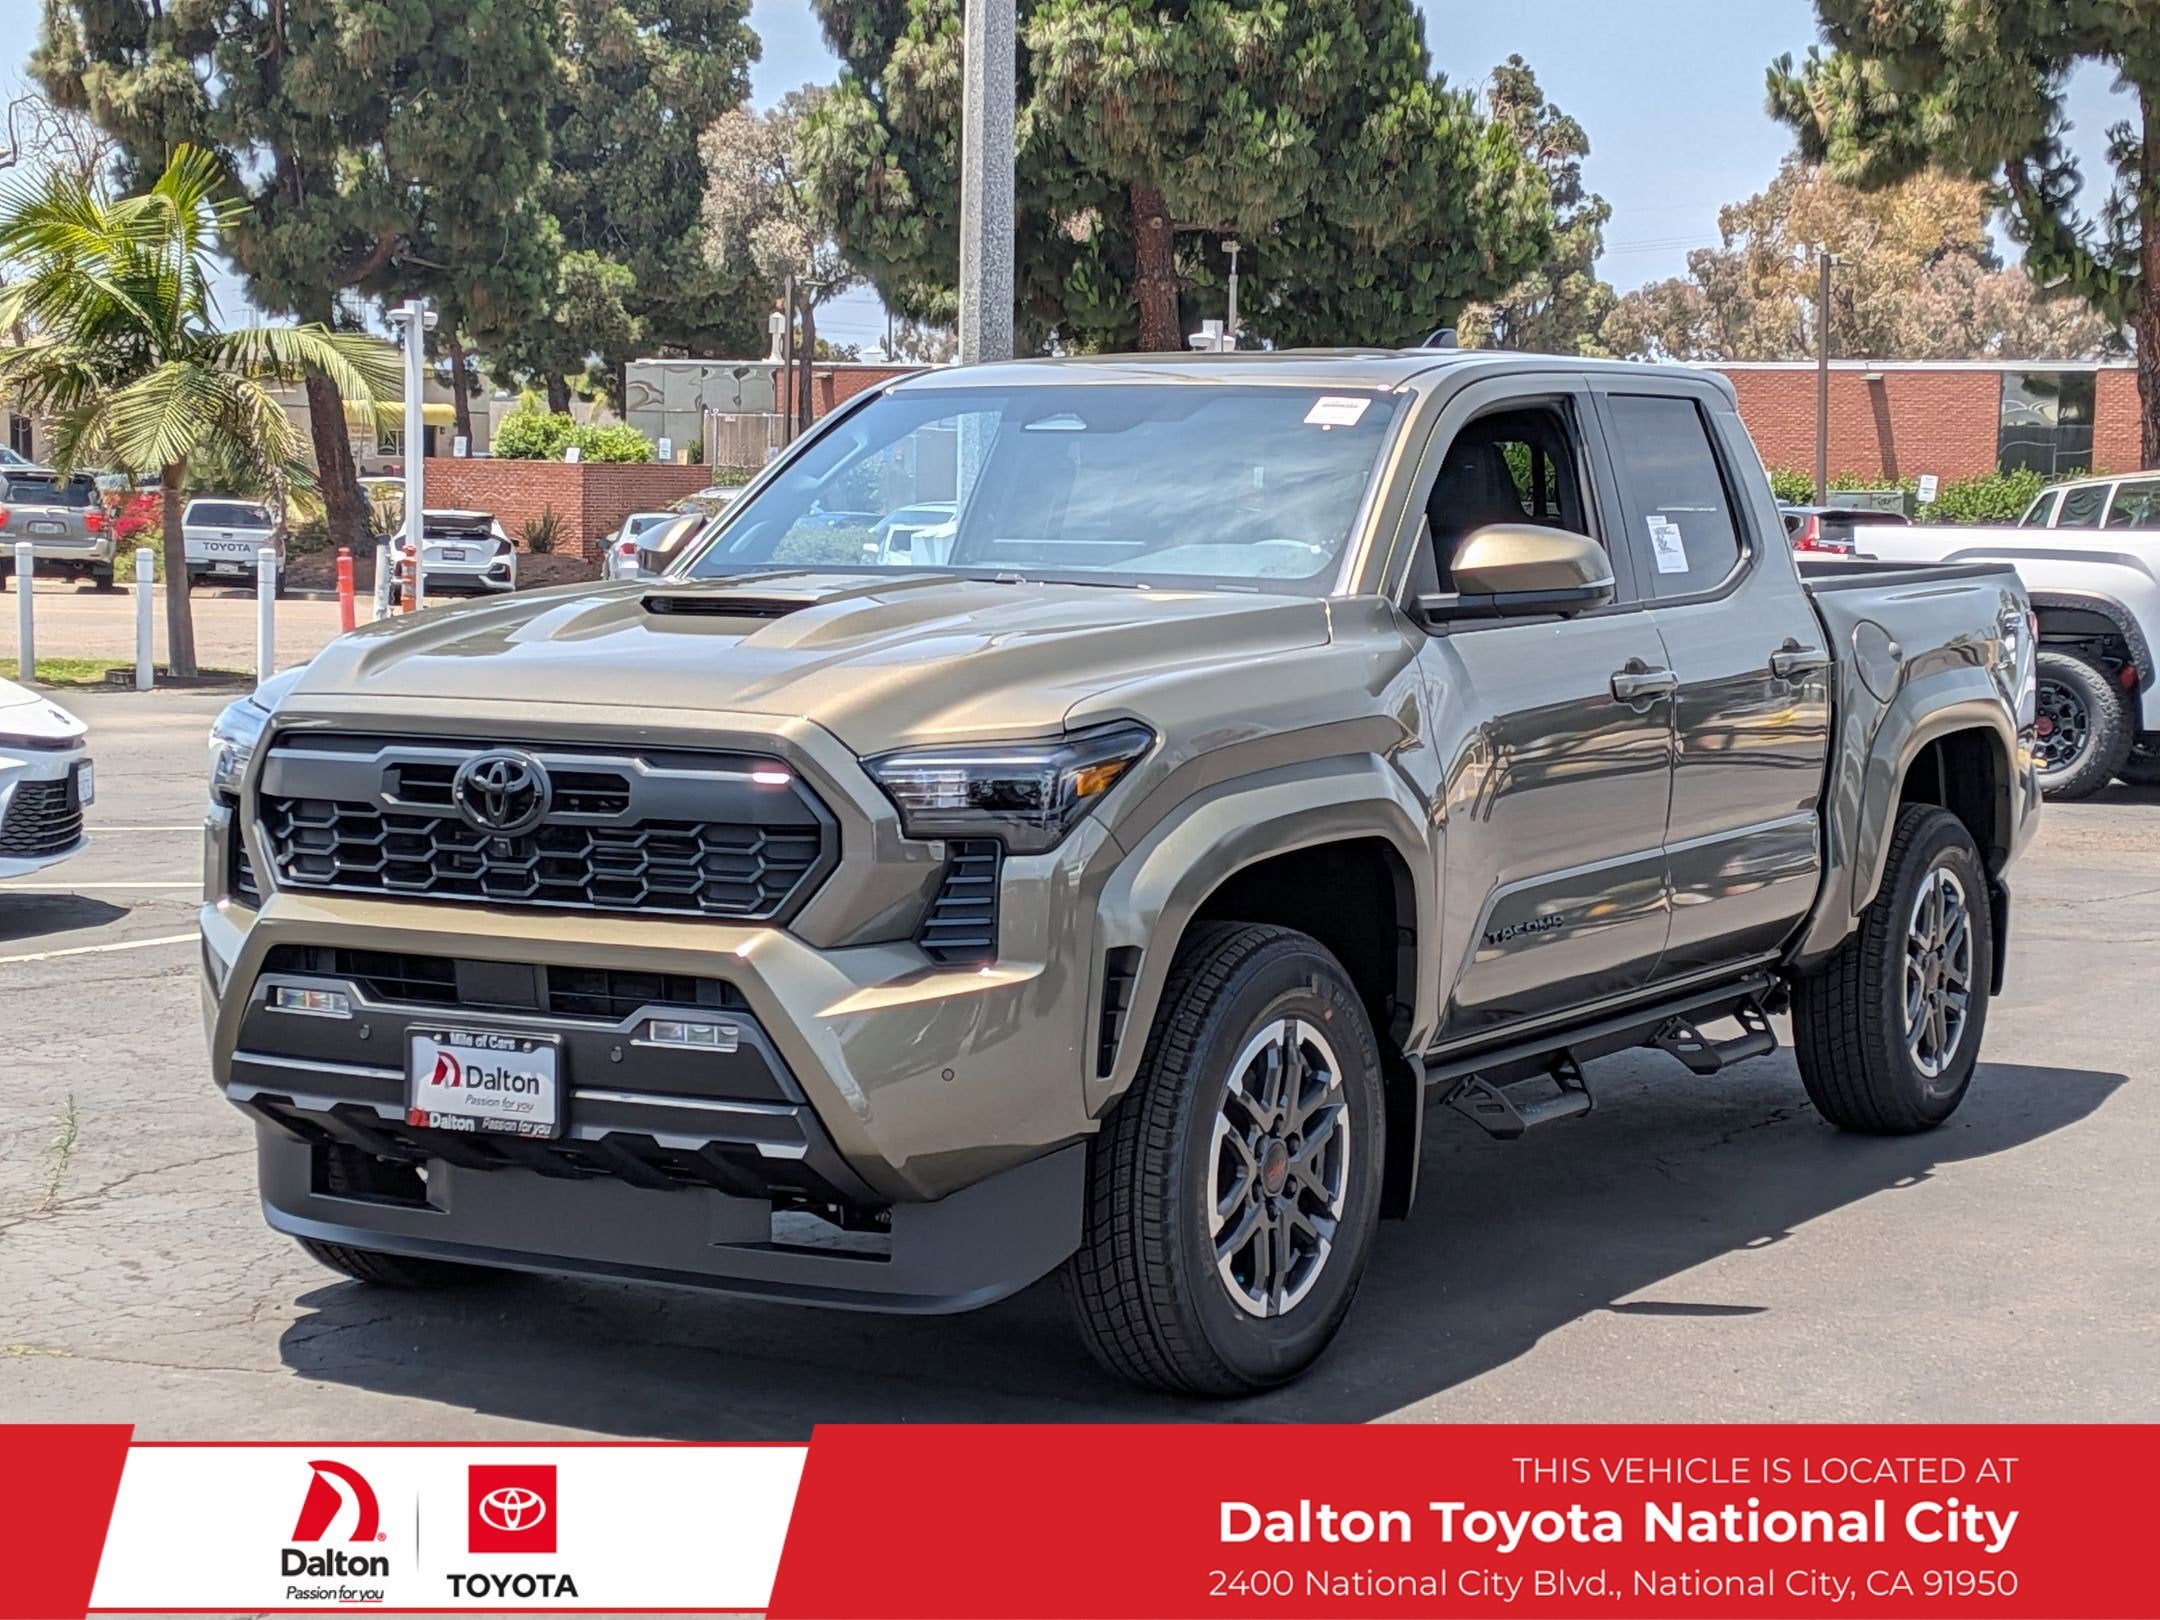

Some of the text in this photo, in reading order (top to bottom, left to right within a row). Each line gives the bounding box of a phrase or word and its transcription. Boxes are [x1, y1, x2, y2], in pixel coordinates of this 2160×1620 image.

[202, 541, 251, 553] TOYOTA
[449, 1031, 516, 1051] Mile of Cars
[466, 1065, 540, 1095] Dalton
[465, 1094, 534, 1112] Passion for you
[429, 1112, 552, 1135] Dalton Passion for you
